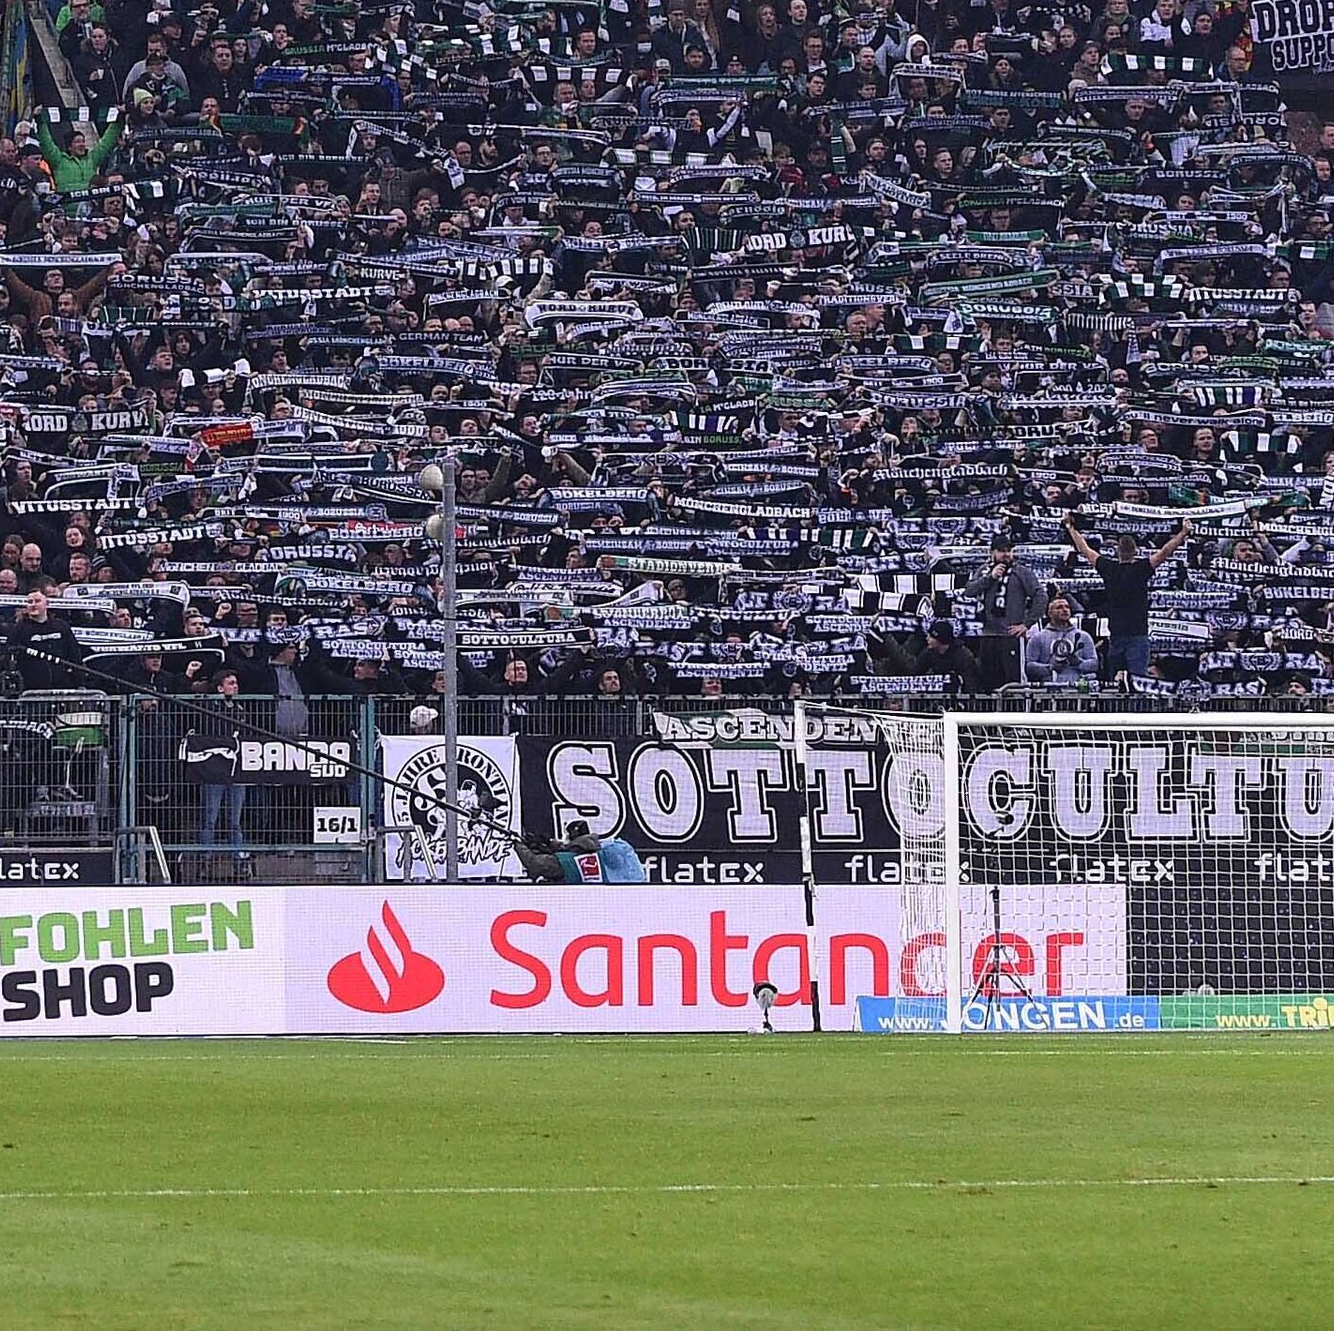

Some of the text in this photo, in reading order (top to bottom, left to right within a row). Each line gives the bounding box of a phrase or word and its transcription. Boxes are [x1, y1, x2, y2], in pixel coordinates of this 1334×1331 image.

[69, 189, 90, 199] ICH
[360, 268, 401, 281] KURVE
[251, 286, 373, 303] VITUSSTADT
[399, 331, 483, 343] GERMAN TEAM
[550, 355, 609, 367] NUR DER
[871, 392, 967, 408] BORUSSIA
[1155, 414, 1265, 428] never walk alone
[872, 462, 1008, 482] Mönchengladbach
[549, 490, 648, 502] BÖKELBERG
[10, 498, 132, 514] VITUSSTADT
[673, 495, 812, 520] MÖNCHENGLADBACH
[512, 513, 559, 525] BORUSSIA
[1093, 519, 1172, 533] ASCENDENTE
[460, 632, 577, 647] SOTTOCULTURA
[1280, 627, 1315, 641] NORD
[675, 668, 764, 678] ASCENDENTE
[860, 682, 945, 693] ASCENDENTE
[1217, 682, 1261, 696] RAS
[241, 740, 351, 771] BANDA
[310, 763, 346, 778] SUD
[315, 816, 357, 835] 16/1
[644, 855, 764, 884] flatex
[1050, 853, 1175, 883] flatex
[492, 909, 1084, 1010] Santander
[2, 962, 174, 1022] SHOP
[1216, 1012, 1278, 1028] www.
